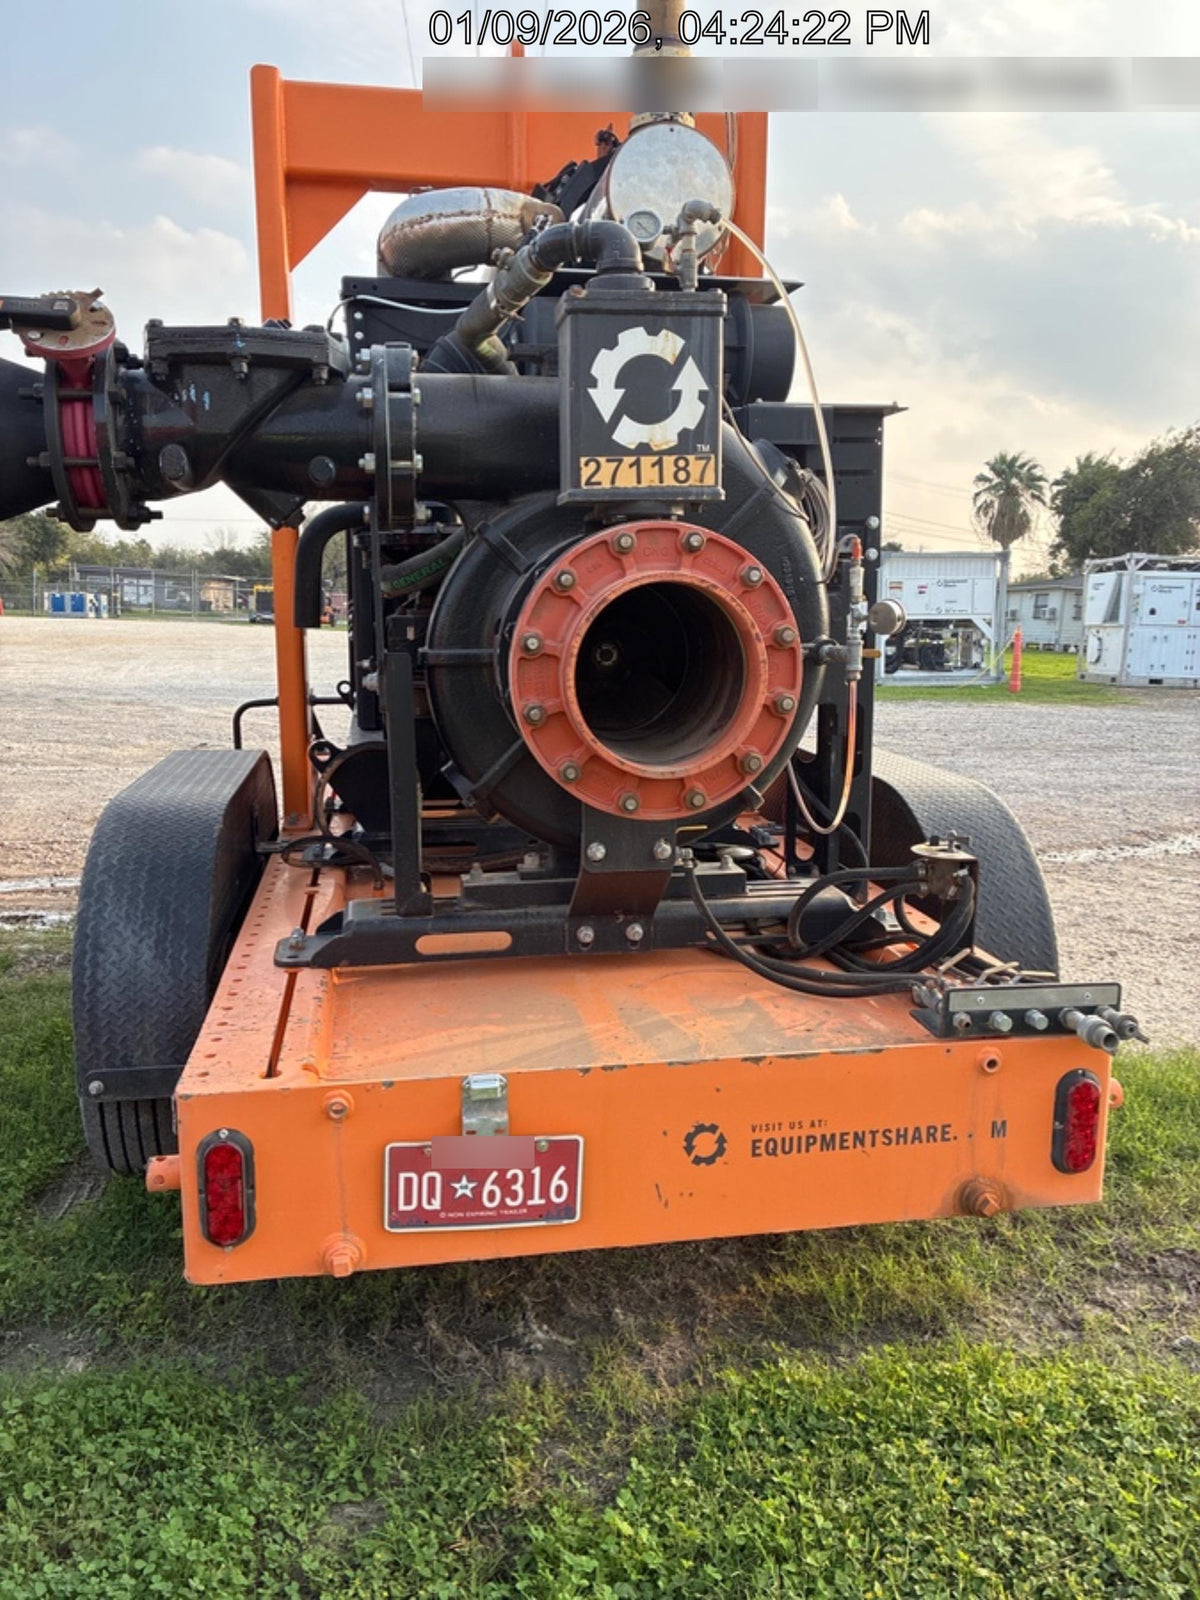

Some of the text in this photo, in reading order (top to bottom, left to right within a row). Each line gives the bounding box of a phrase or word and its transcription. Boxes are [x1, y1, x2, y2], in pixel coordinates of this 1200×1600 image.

[584, 456, 712, 486] 271187
[751, 1119, 828, 1133] VISIT US AT:
[481, 1165, 569, 1209] 6316
